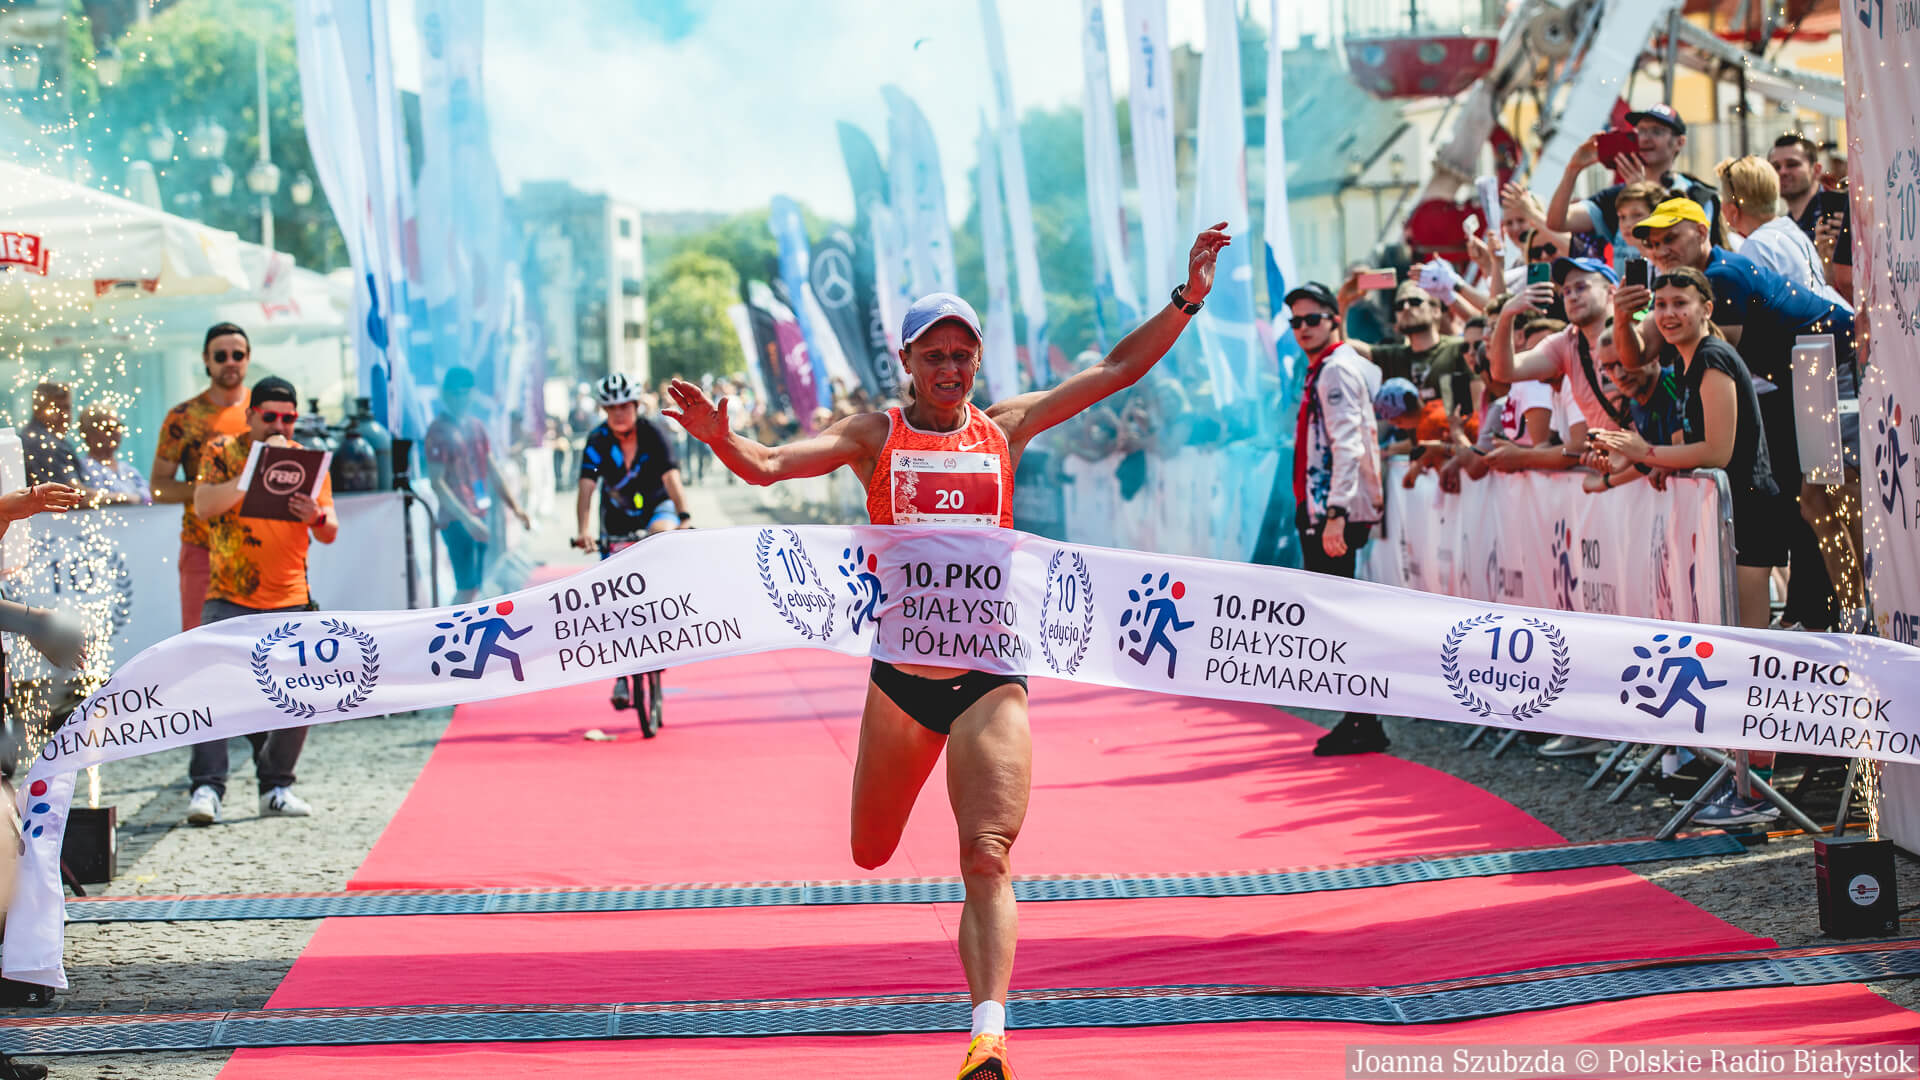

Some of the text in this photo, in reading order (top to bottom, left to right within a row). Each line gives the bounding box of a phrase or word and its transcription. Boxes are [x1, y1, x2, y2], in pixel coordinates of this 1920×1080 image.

[1898, 183, 1915, 240] 10
[935, 489, 965, 510] 20
[777, 548, 806, 586] 10
[1581, 539, 1600, 569] PKO
[787, 589, 827, 613] edycja
[1057, 574, 1076, 613] 10
[554, 592, 699, 640] BIAŁYSTOK
[1048, 618, 1079, 647] edycja
[288, 638, 339, 667] 10
[559, 617, 742, 672] PÓŁMARATON
[1210, 626, 1348, 665] BIAŁYSTOK
[1484, 626, 1534, 663] 10
[285, 669, 355, 691] edycja
[1205, 655, 1390, 699] PÓŁMARATON
[1468, 666, 1540, 694] edycja
[1746, 685, 1892, 723] BIAŁYSTOK
